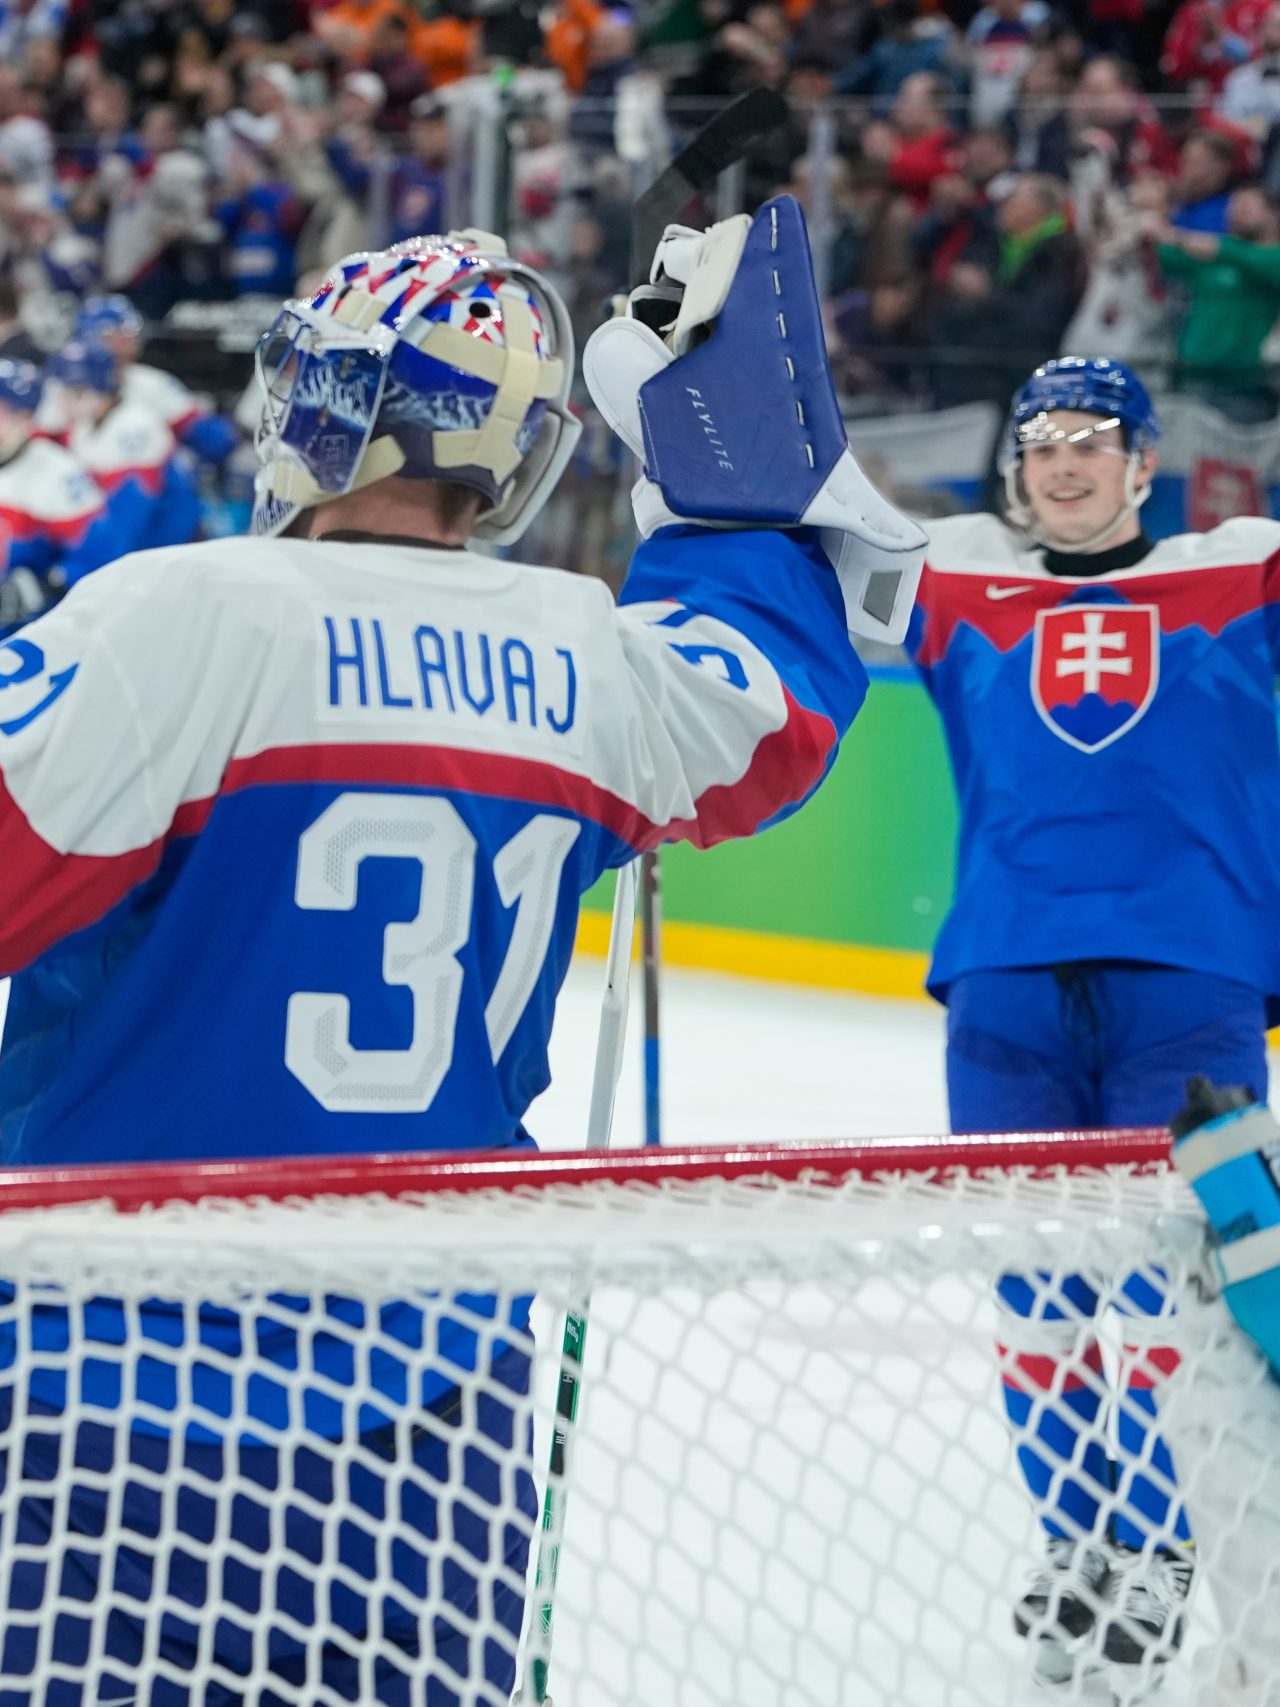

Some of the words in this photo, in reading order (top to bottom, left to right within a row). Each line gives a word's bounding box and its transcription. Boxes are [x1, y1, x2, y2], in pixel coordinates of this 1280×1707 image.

[685, 386, 734, 472] FLYLITE
[324, 616, 577, 734] HLAVAJ
[284, 792, 582, 1113] 31
